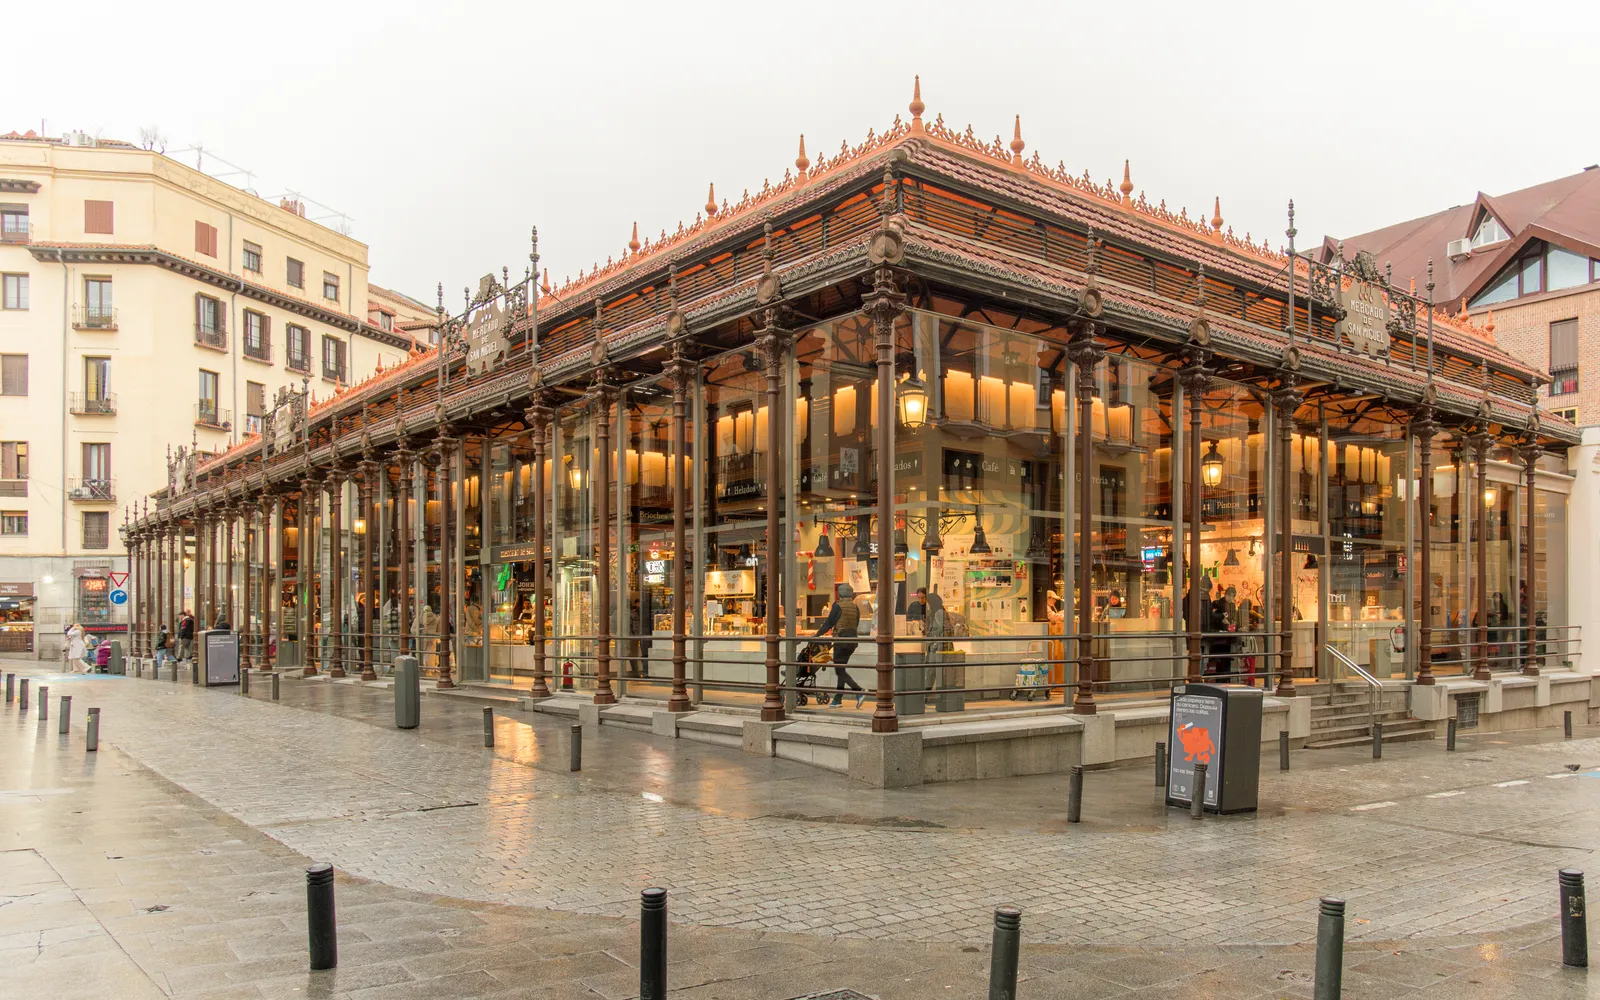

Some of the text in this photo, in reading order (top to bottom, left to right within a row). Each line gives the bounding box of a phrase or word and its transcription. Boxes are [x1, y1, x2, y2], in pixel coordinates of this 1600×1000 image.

[1350, 300, 1384, 320] MERCADO
[1363, 316, 1373, 326] DE
[472, 318, 499, 339] MERCADO
[1348, 322, 1384, 344] SAN MIGUEL
[481, 335, 489, 345] DE
[469, 342, 498, 362] SAN MIGUEL
[894, 460, 912, 471] ados
[981, 460, 999, 473] Café
[813, 472, 828, 483] Café
[734, 484, 756, 495] Helados
[639, 510, 668, 519] Brioches
